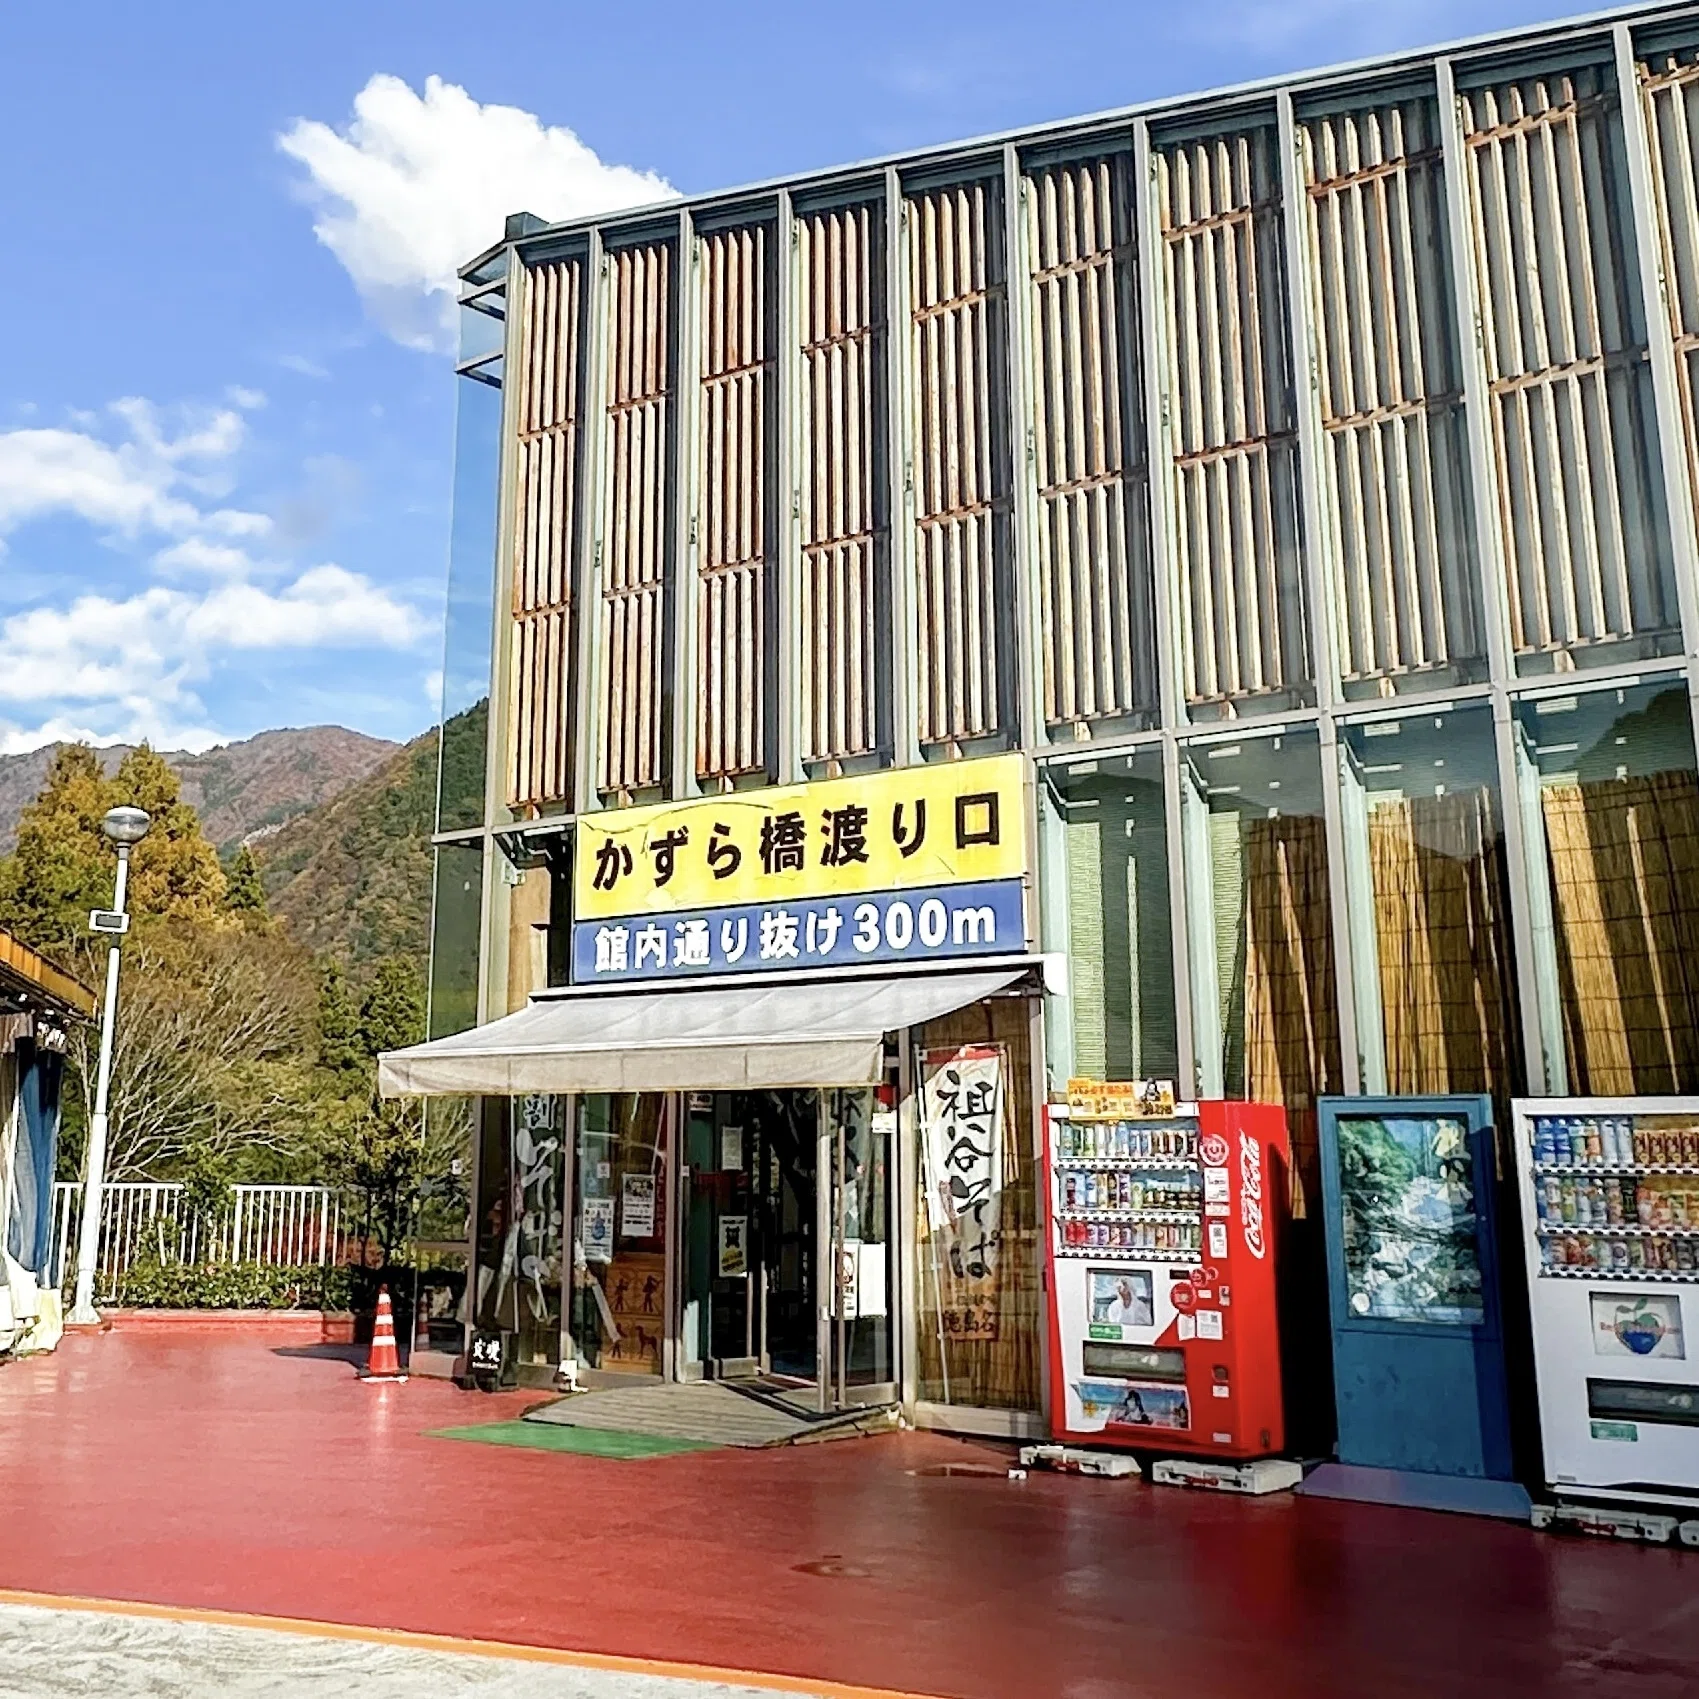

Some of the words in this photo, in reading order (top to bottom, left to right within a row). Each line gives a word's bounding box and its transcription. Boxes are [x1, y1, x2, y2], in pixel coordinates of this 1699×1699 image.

[593, 791, 1000, 891] かずら橋渡り口
[594, 898, 996, 974] 館内通り抜け300m
[937, 1069, 998, 1279] 祖谷そば
[1239, 1127, 1265, 1260] Coca-Cola
